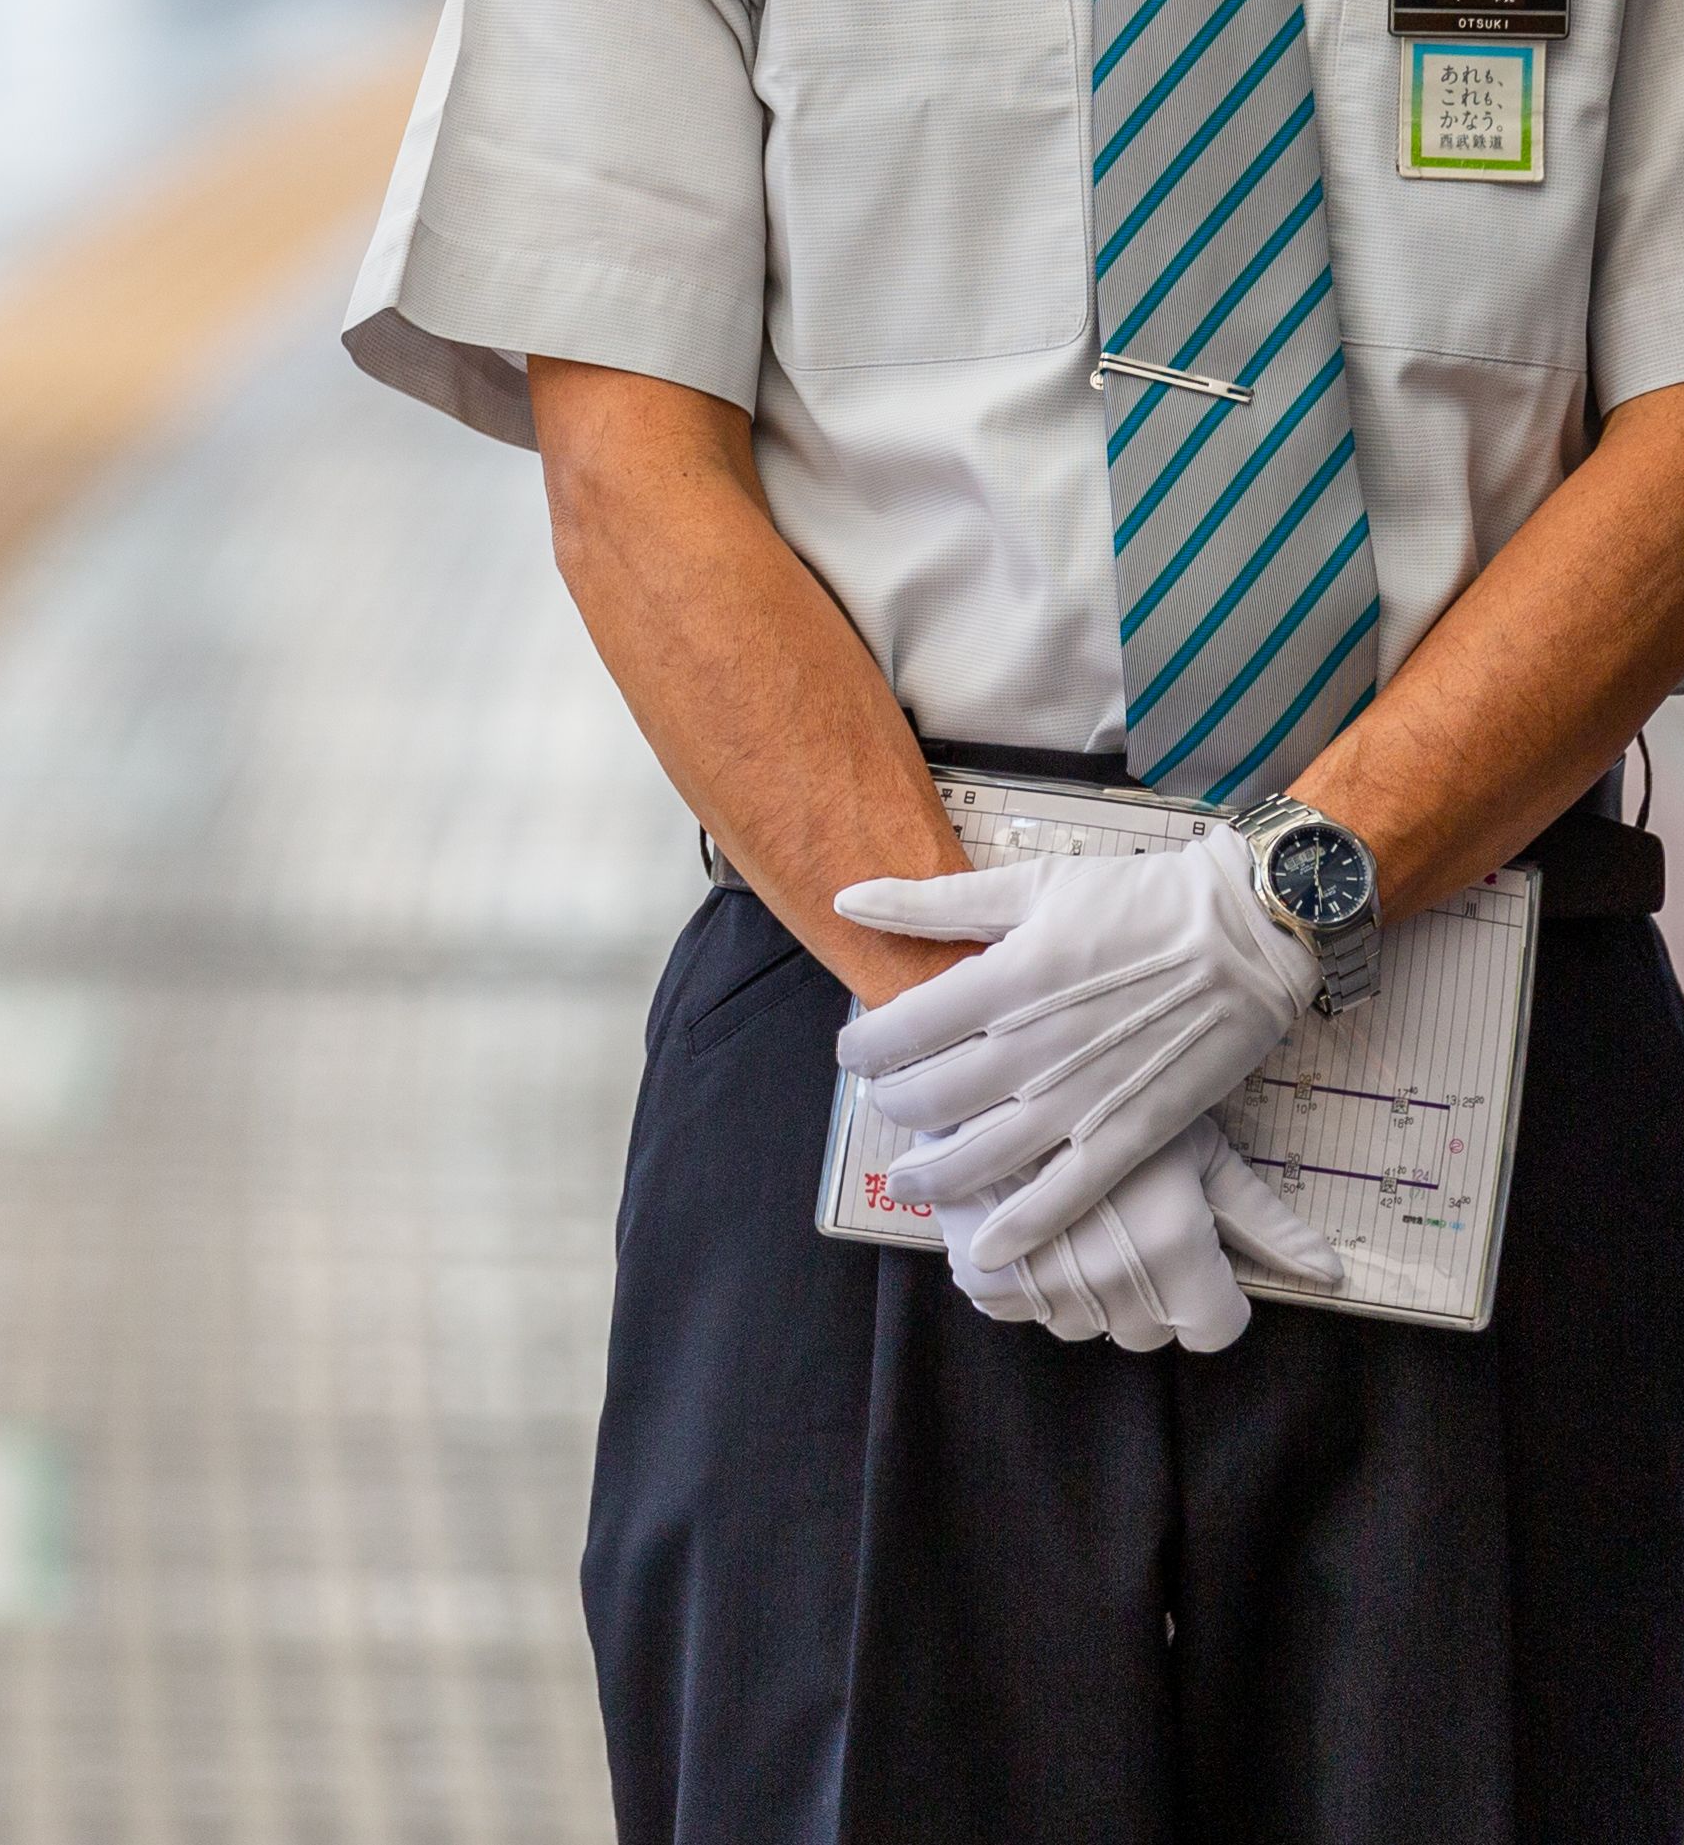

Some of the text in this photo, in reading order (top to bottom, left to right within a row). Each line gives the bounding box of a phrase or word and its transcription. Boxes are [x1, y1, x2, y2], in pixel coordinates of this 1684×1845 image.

[1458, 18, 1509, 29] OTSUKI
[1440, 65, 1503, 87] あれも、
[1441, 88, 1503, 109] これも、
[1439, 110, 1503, 132] かなう。
[1439, 133, 1503, 150] 西武鉄道
